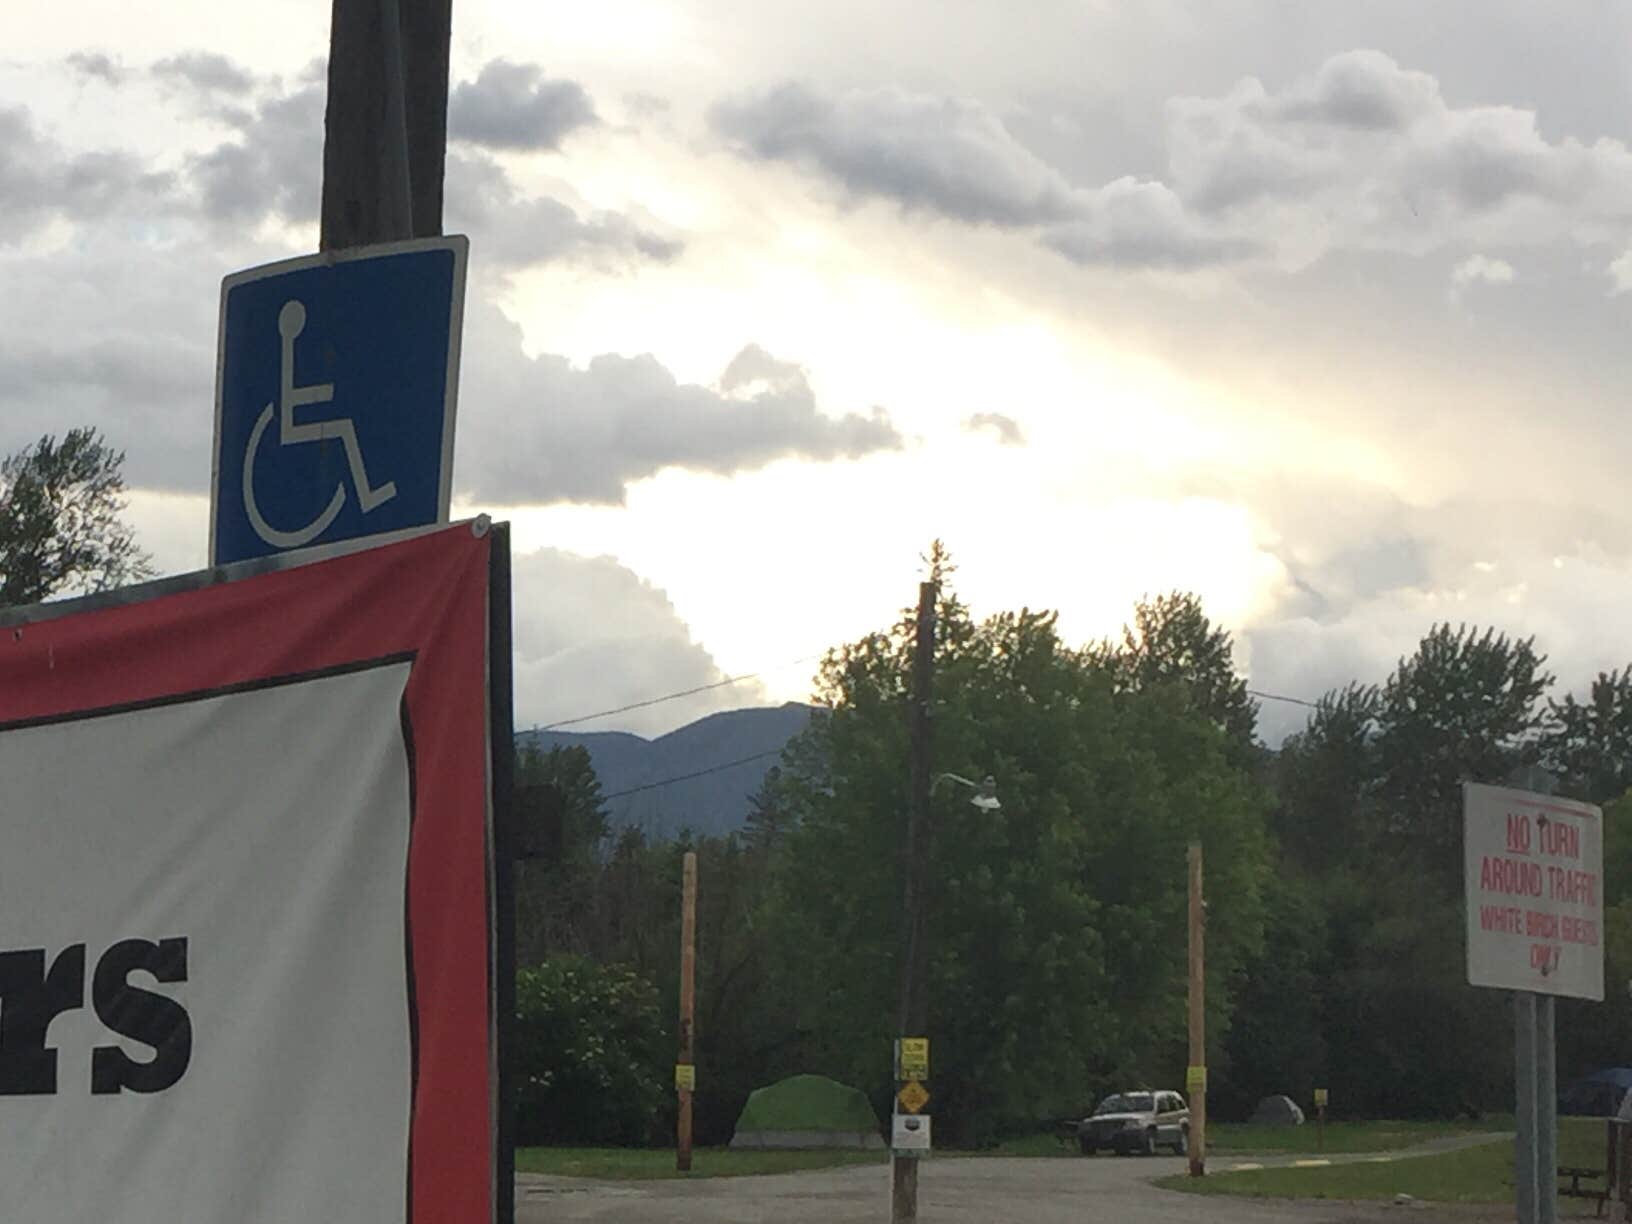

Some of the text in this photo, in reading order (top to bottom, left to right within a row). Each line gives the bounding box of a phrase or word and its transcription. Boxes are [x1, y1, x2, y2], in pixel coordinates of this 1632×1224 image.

[1506, 813, 1580, 859] NO TURN
[1480, 855, 1543, 897] AROUND
[1480, 905, 1523, 935] WHITE
